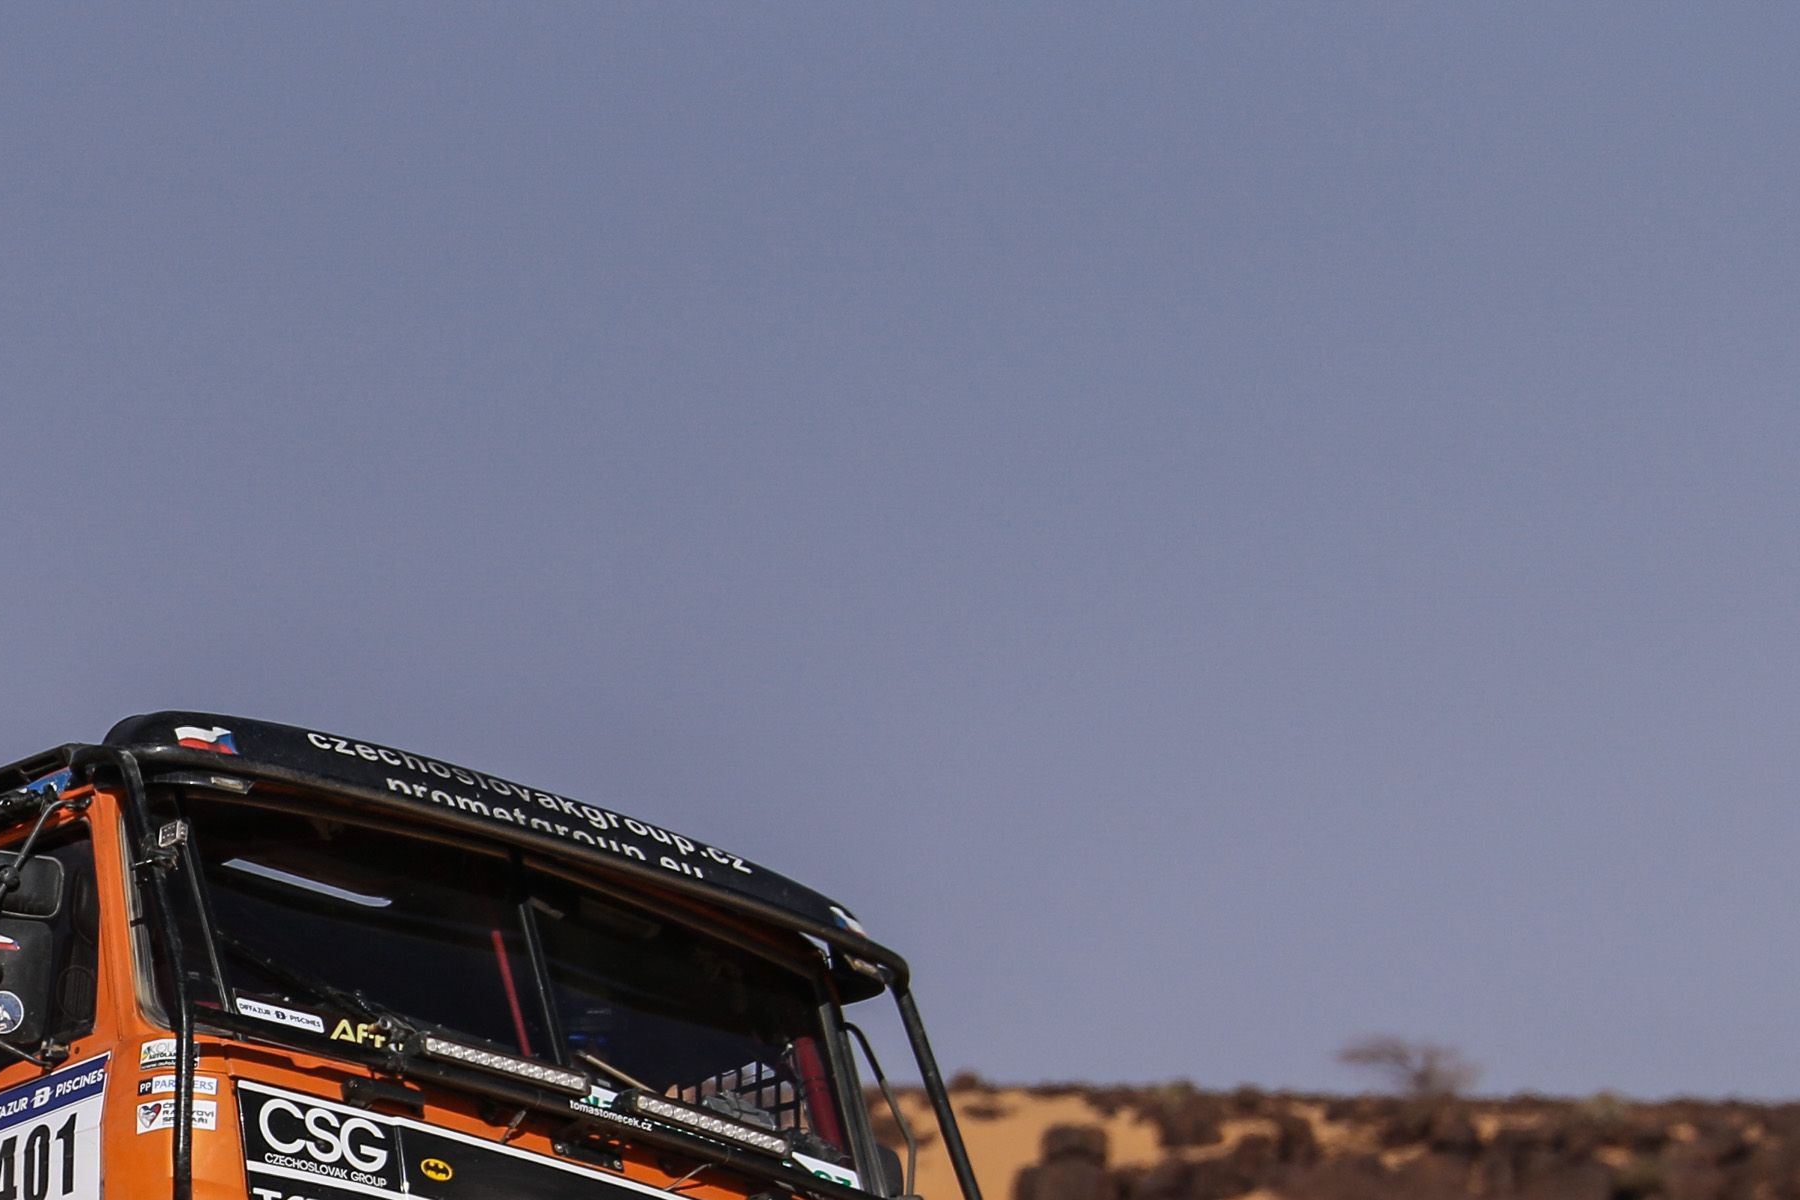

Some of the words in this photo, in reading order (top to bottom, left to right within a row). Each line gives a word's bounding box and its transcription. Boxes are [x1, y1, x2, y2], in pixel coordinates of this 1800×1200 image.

[55, 1068, 104, 1098] PISCINES
[259, 1098, 388, 1173] CSG
[264, 1152, 348, 1180] CZECHOSLOVAK
[350, 1171, 387, 1188] GROUP
